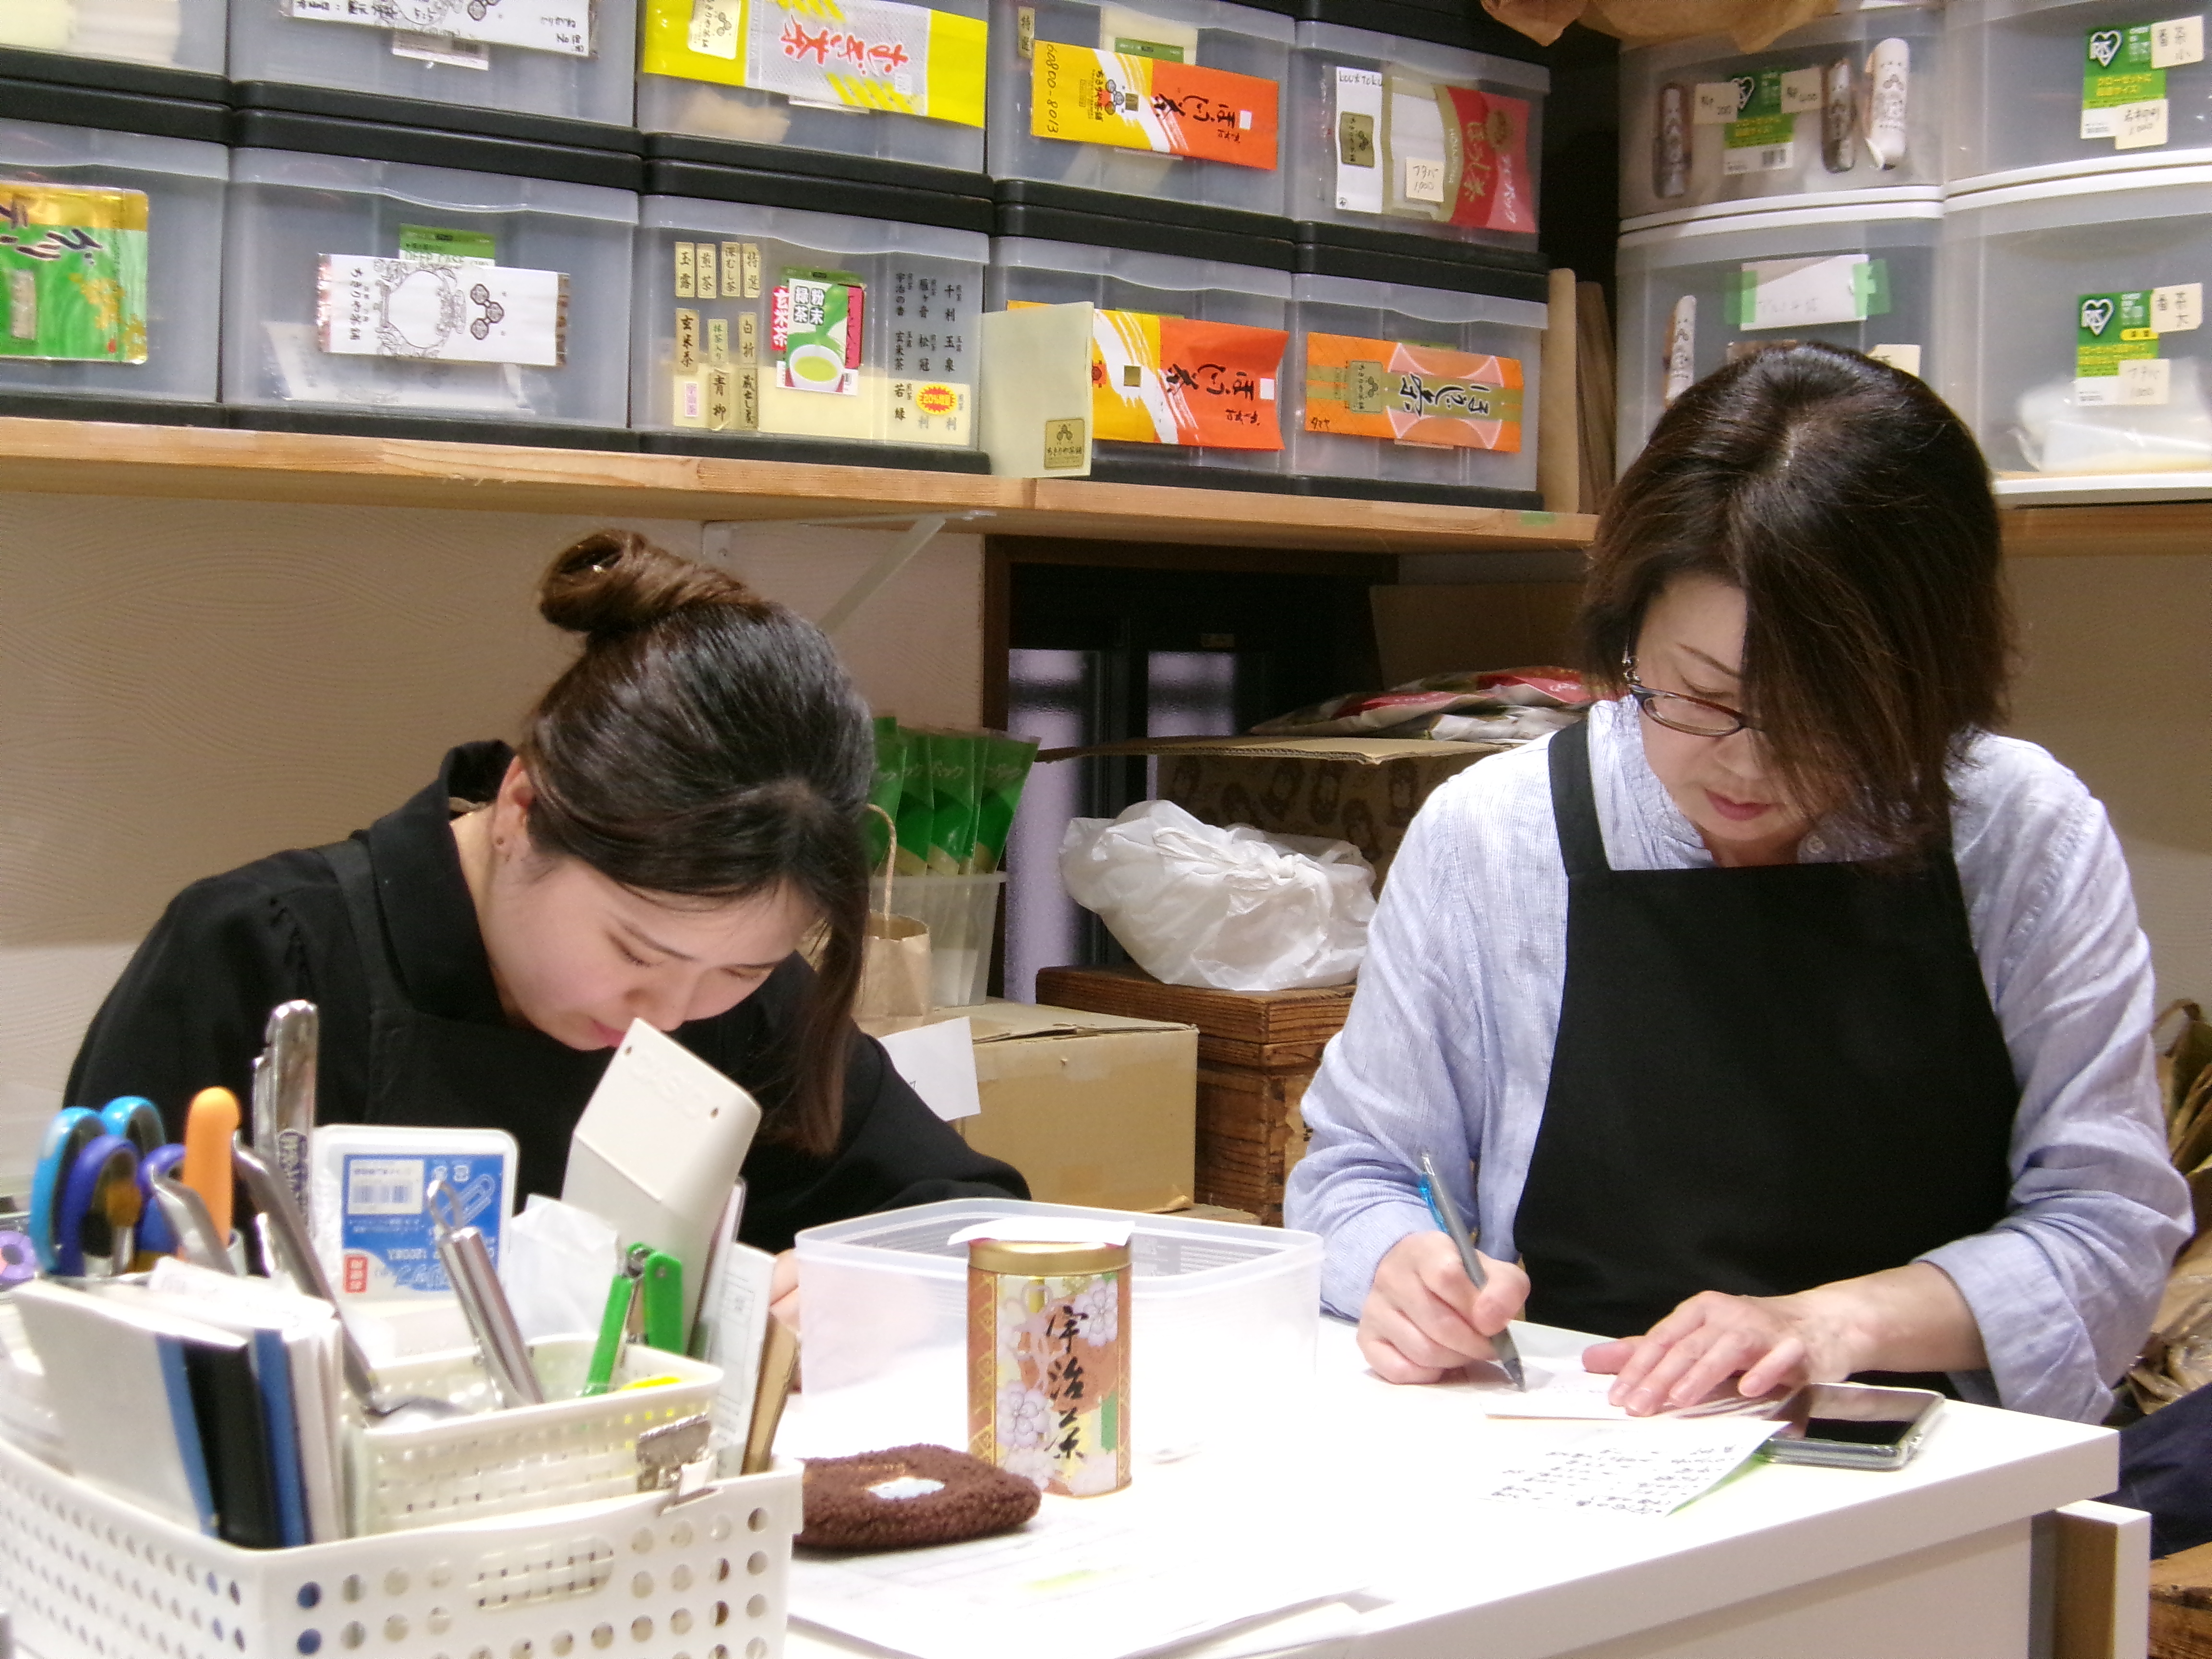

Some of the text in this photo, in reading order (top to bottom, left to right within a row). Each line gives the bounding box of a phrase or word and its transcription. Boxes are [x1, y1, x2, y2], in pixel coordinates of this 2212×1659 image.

[781, 14, 908, 75] むぎ茶
[1151, 93, 1237, 128] ほうじ茶
[773, 288, 788, 348] 玄米茶
[810, 287, 825, 325] 粉末
[1166, 363, 1254, 400] ほうじ茶
[1400, 373, 1490, 417] ほうじ茶
